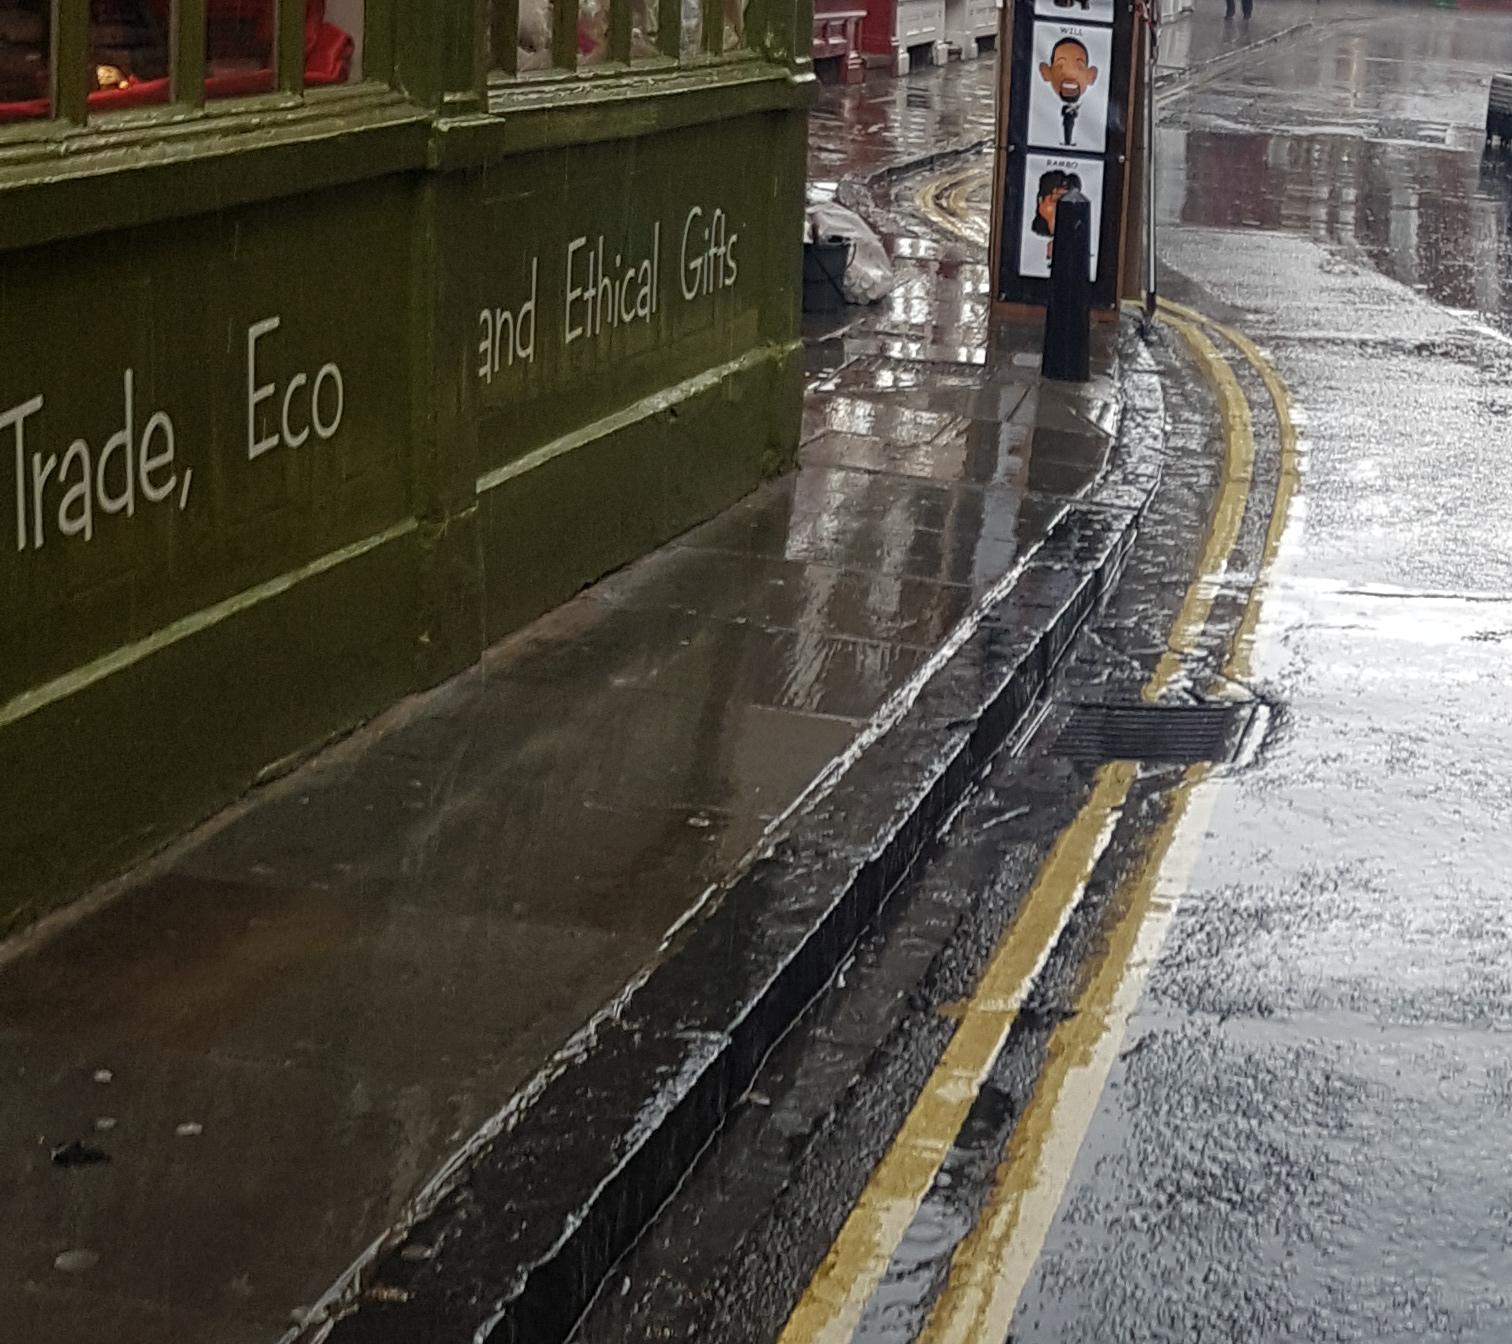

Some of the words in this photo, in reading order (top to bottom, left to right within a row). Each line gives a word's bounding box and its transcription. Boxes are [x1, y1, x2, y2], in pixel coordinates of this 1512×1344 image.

[1059, 26, 1083, 37] WILL
[1046, 159, 1078, 170] RAMBO
[247, 316, 345, 461] Eco
[478, 257, 536, 385] and
[564, 221, 661, 346] Ethical
[680, 205, 740, 302] Gifts
